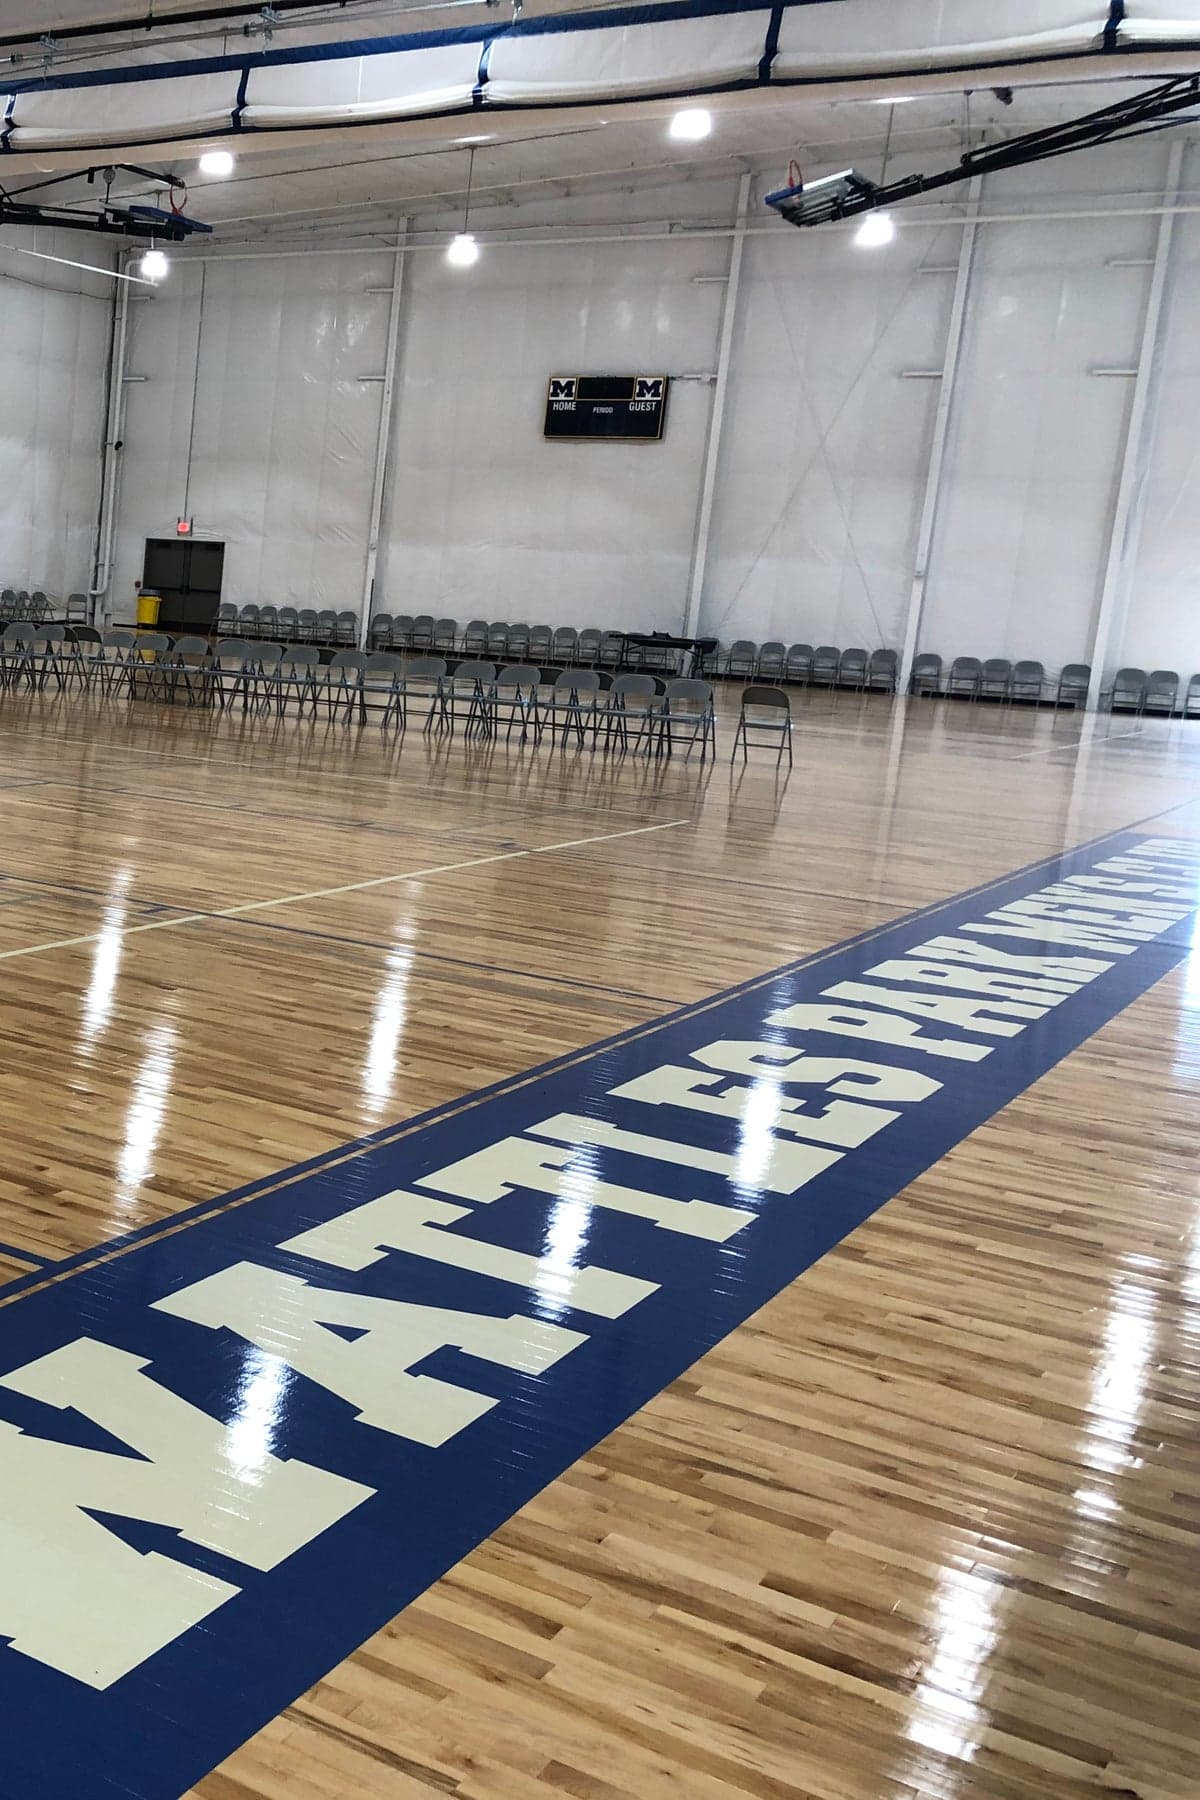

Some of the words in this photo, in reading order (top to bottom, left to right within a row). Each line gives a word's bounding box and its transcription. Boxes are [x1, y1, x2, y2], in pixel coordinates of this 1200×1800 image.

[550, 380, 575, 398] M
[636, 380, 662, 398] M
[552, 401, 577, 411] HOME
[629, 401, 657, 412] GUEST
[762, 935, 1116, 1062] PARK
